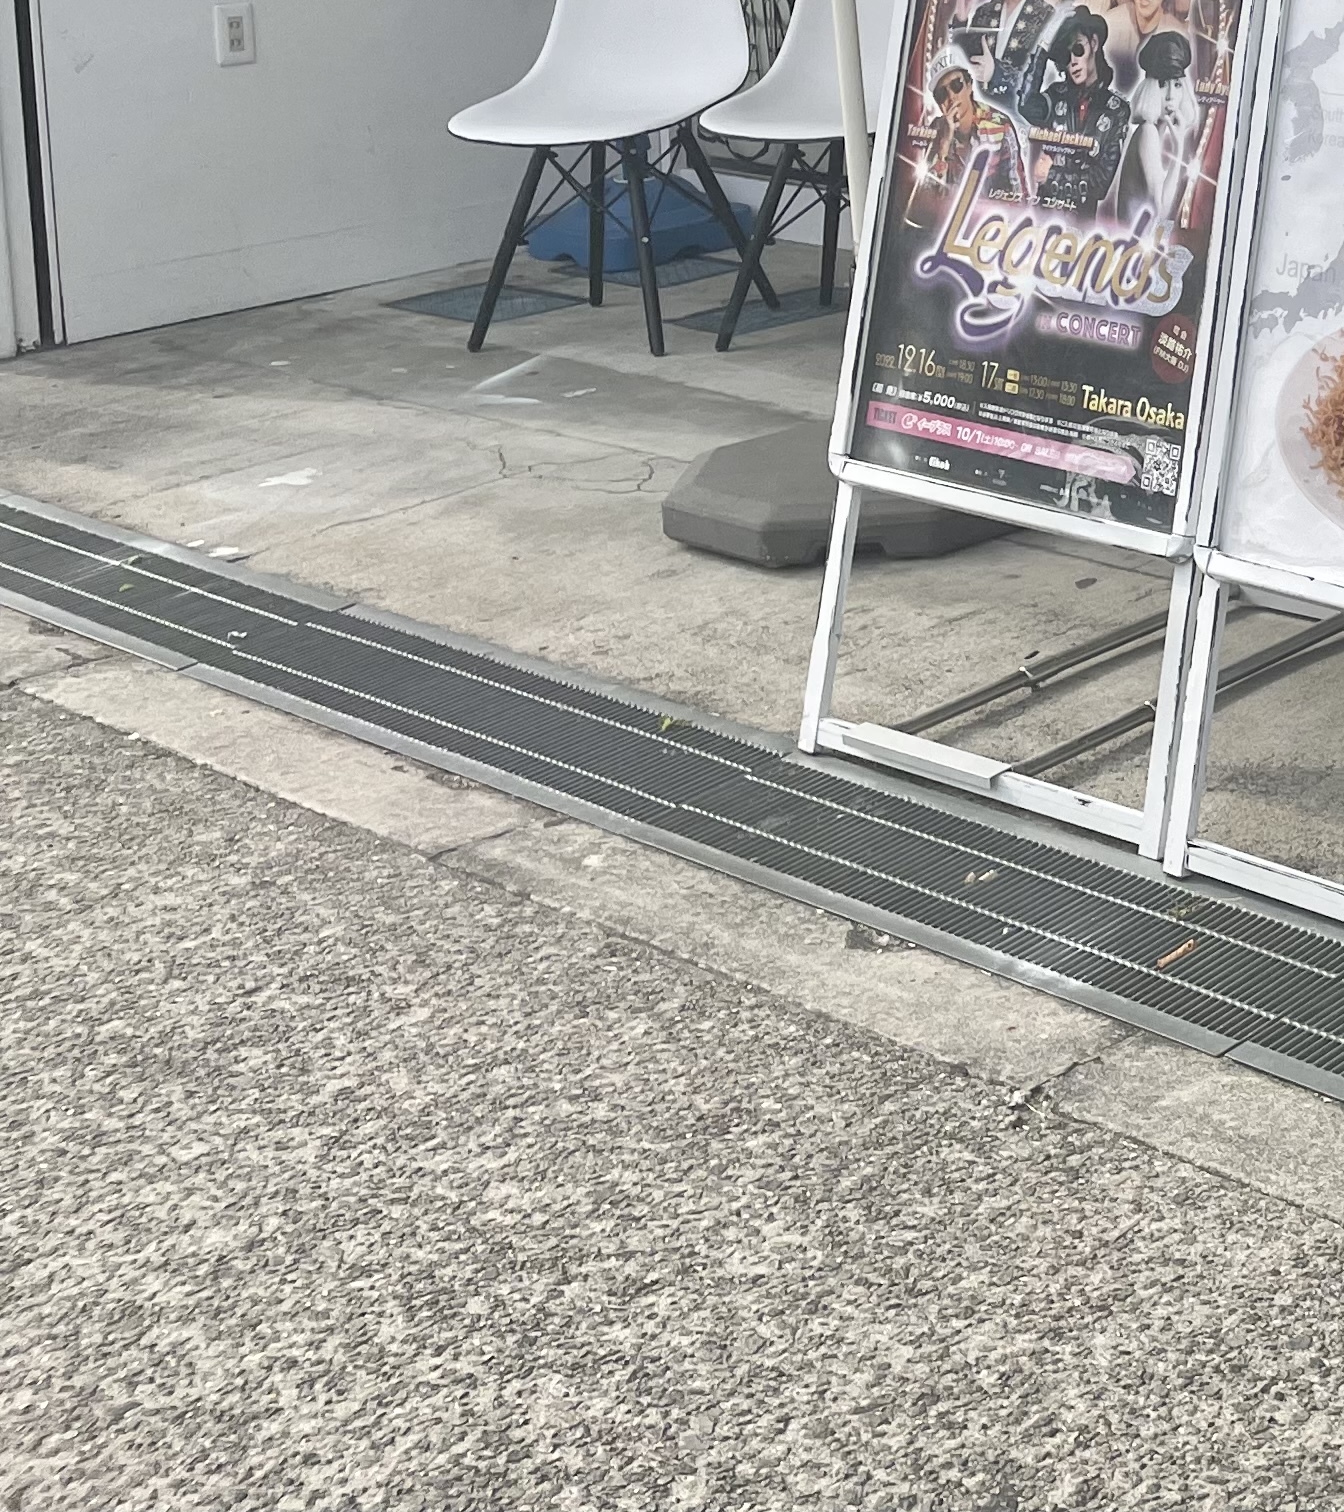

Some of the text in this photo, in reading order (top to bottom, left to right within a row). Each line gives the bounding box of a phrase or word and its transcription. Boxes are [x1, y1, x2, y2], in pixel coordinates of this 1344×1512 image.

[1029, 127, 1061, 142] Michael
[1276, 253, 1337, 284] Japan
[1056, 312, 1142, 345] CONCERT
[1081, 385, 1132, 418] Takara
[1136, 396, 1185, 430] Osaka
